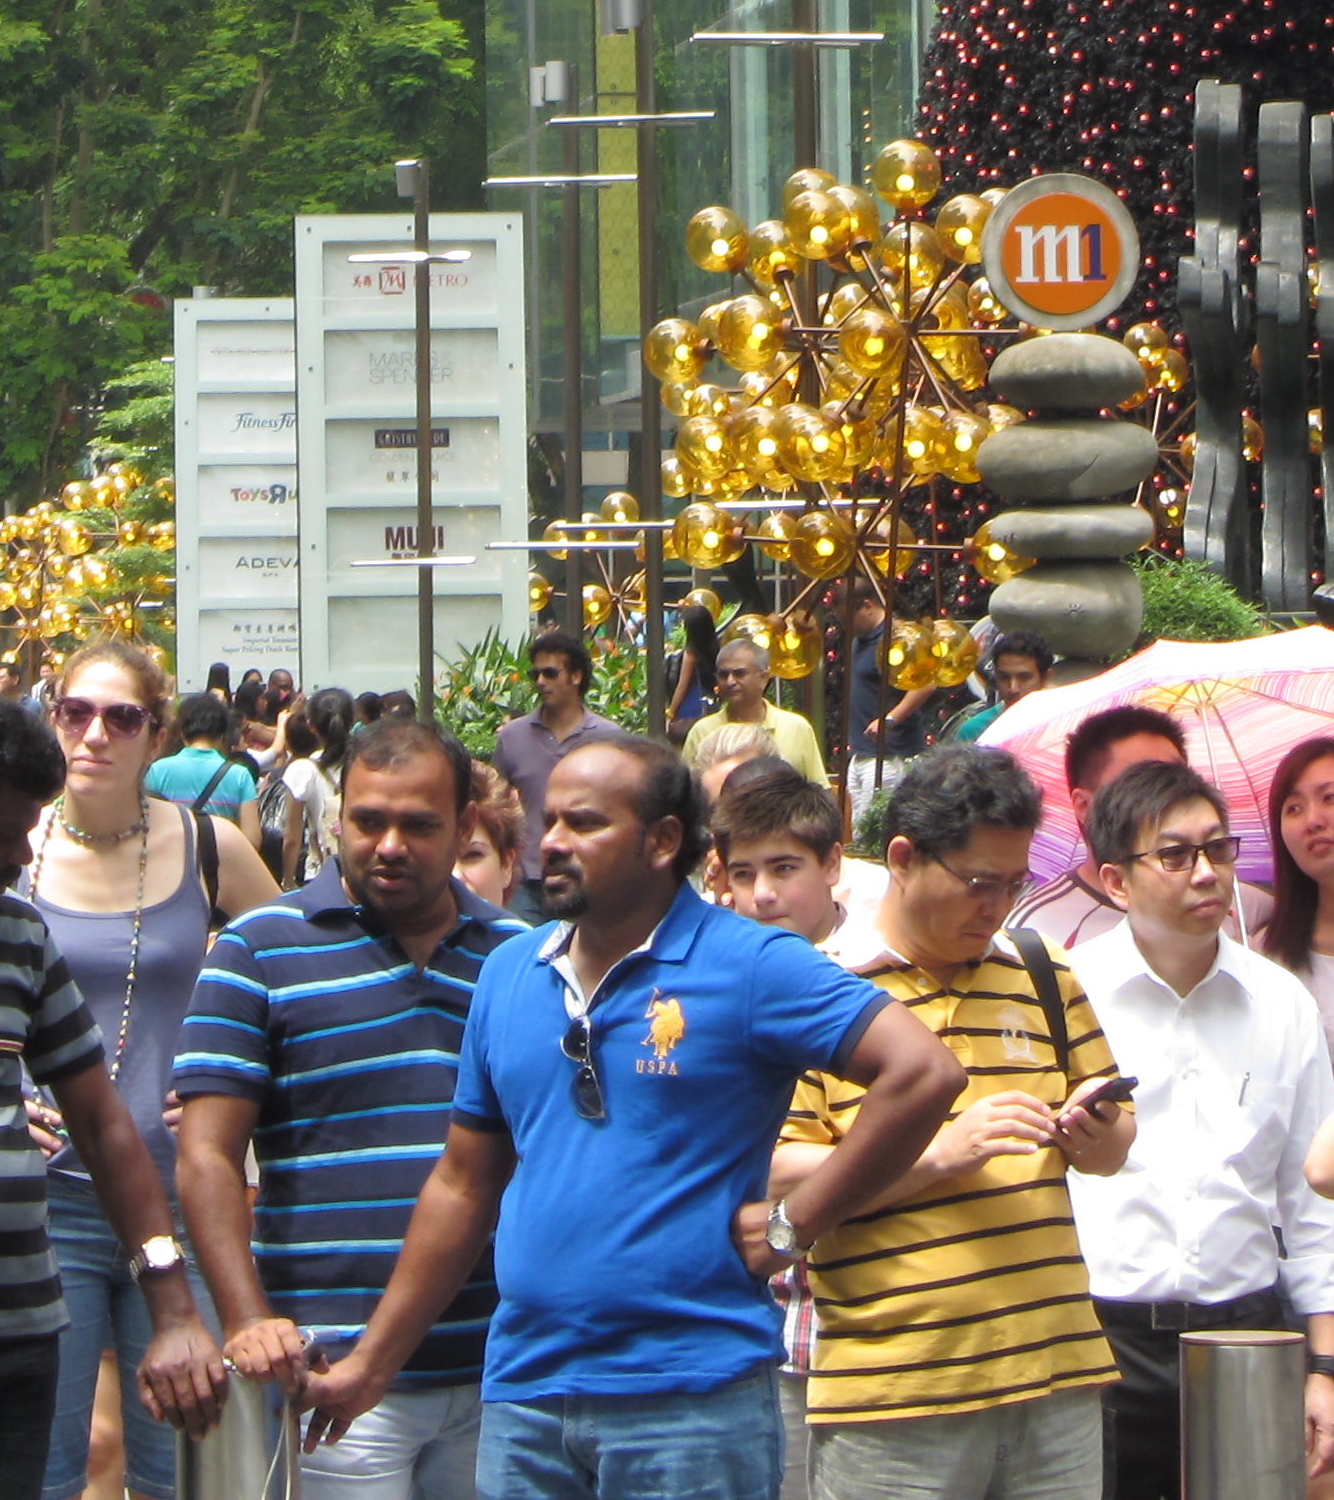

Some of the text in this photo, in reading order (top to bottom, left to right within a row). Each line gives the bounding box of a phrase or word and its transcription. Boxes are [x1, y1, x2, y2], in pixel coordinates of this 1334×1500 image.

[369, 352, 439, 367] MARS
[369, 368, 453, 384] SPENER
[636, 1059, 678, 1076] USPA
